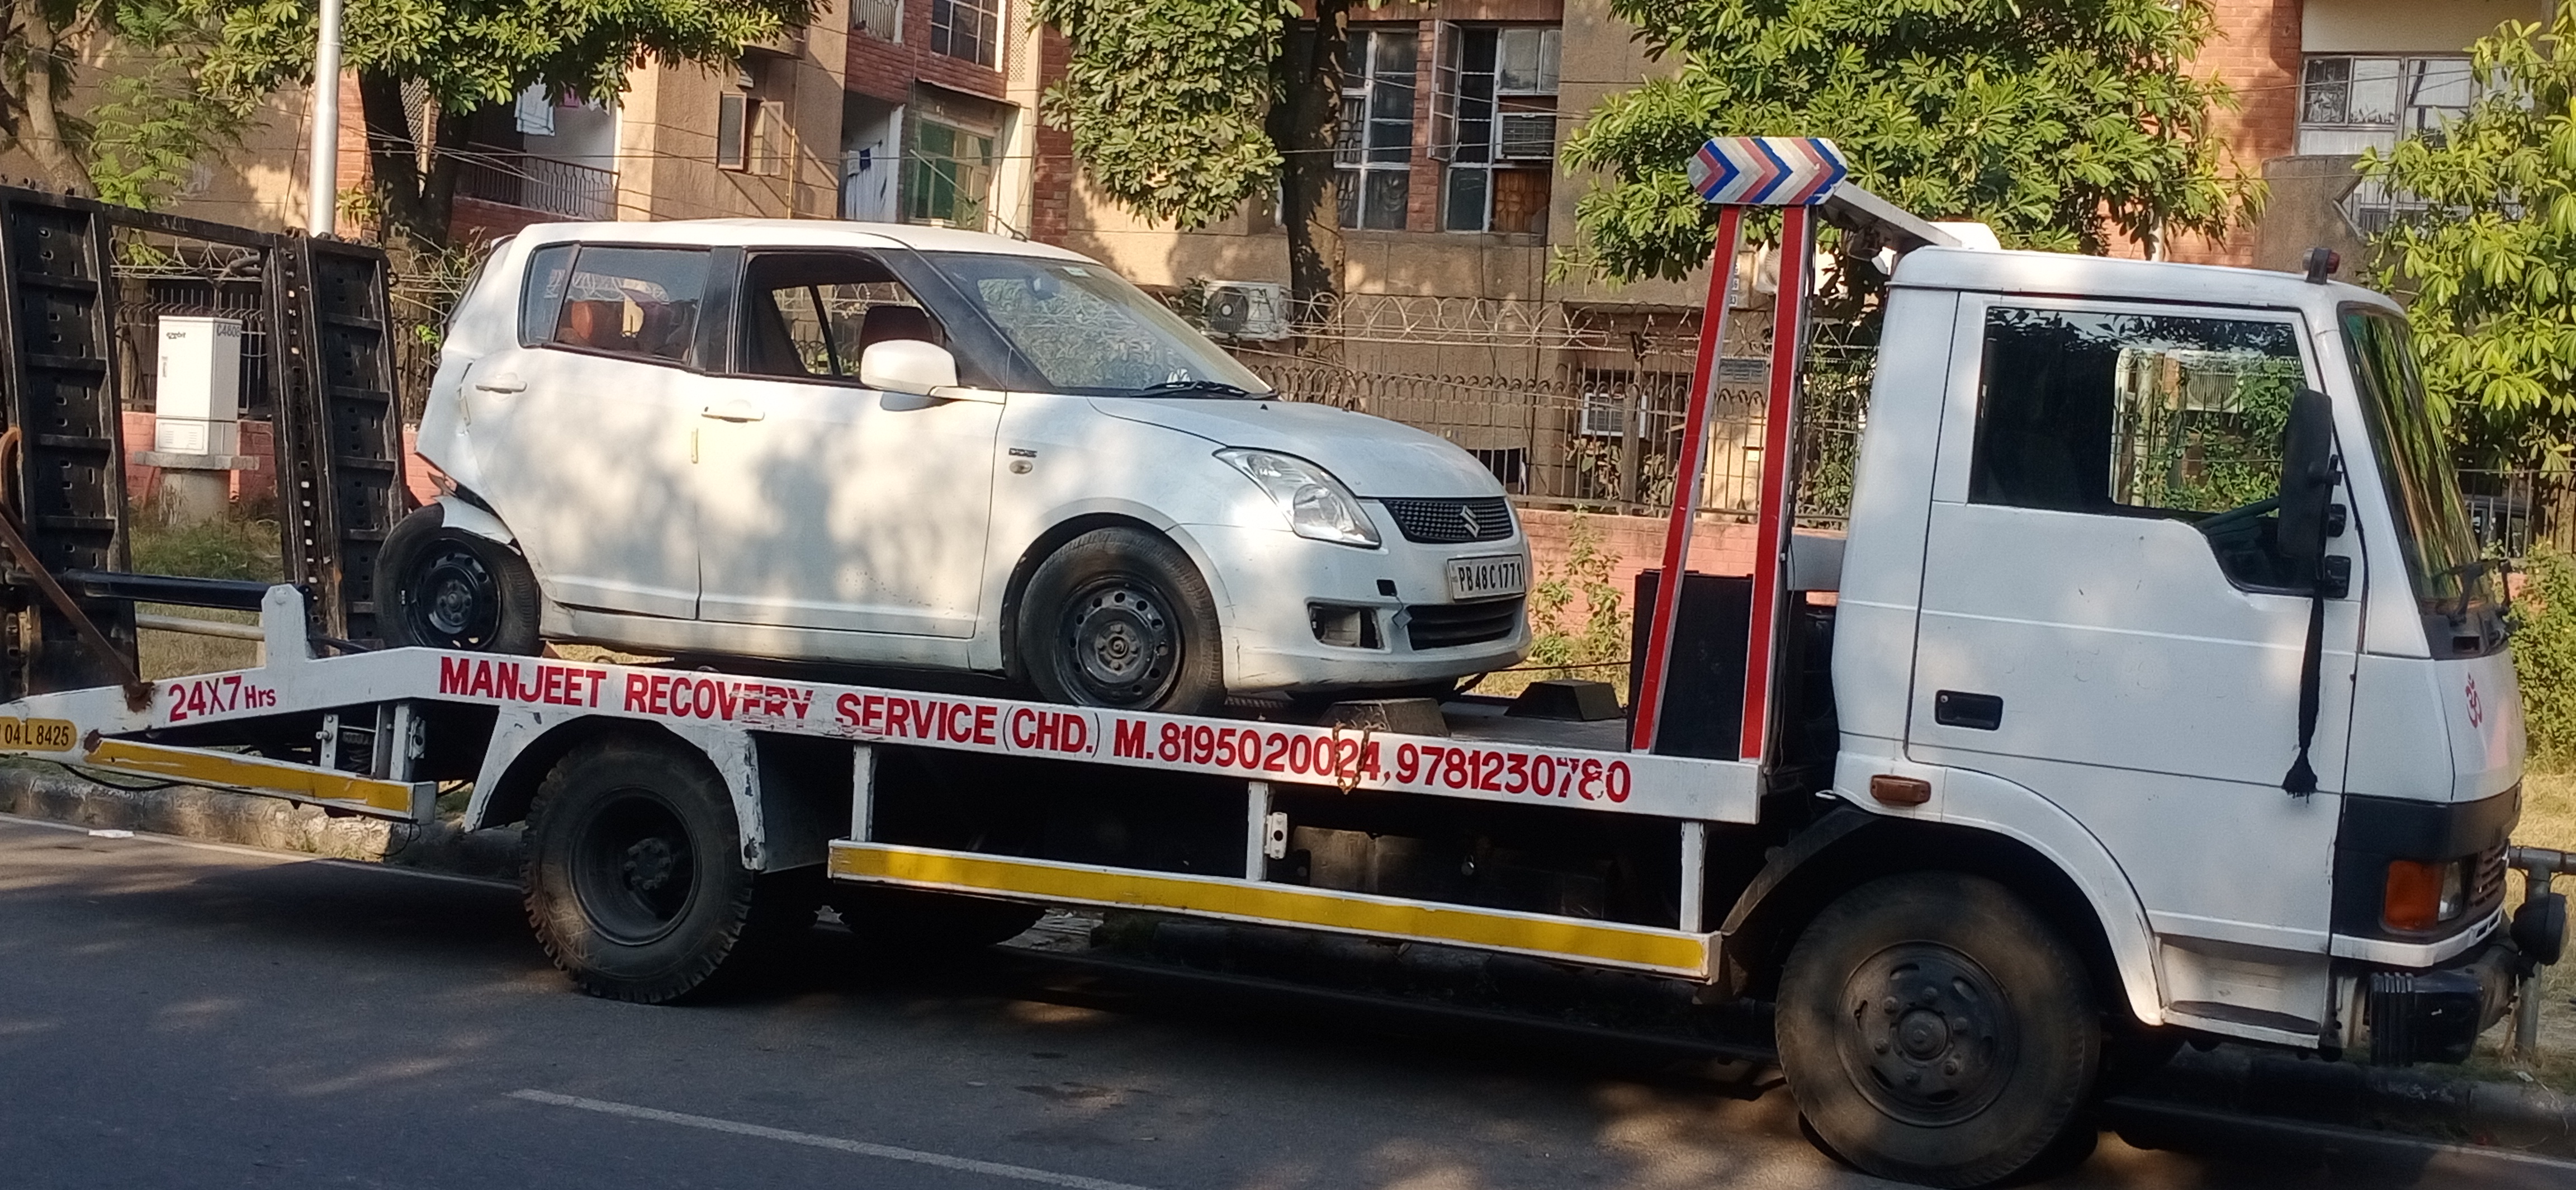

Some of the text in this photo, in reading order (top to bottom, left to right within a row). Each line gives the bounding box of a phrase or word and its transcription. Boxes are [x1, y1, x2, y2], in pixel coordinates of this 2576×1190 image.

[244, 685, 276, 709] Hrs
[440, 657, 606, 707] MANJEET
[624, 674, 813, 727] RECOVERY
[36, 725, 69, 747] 8425
